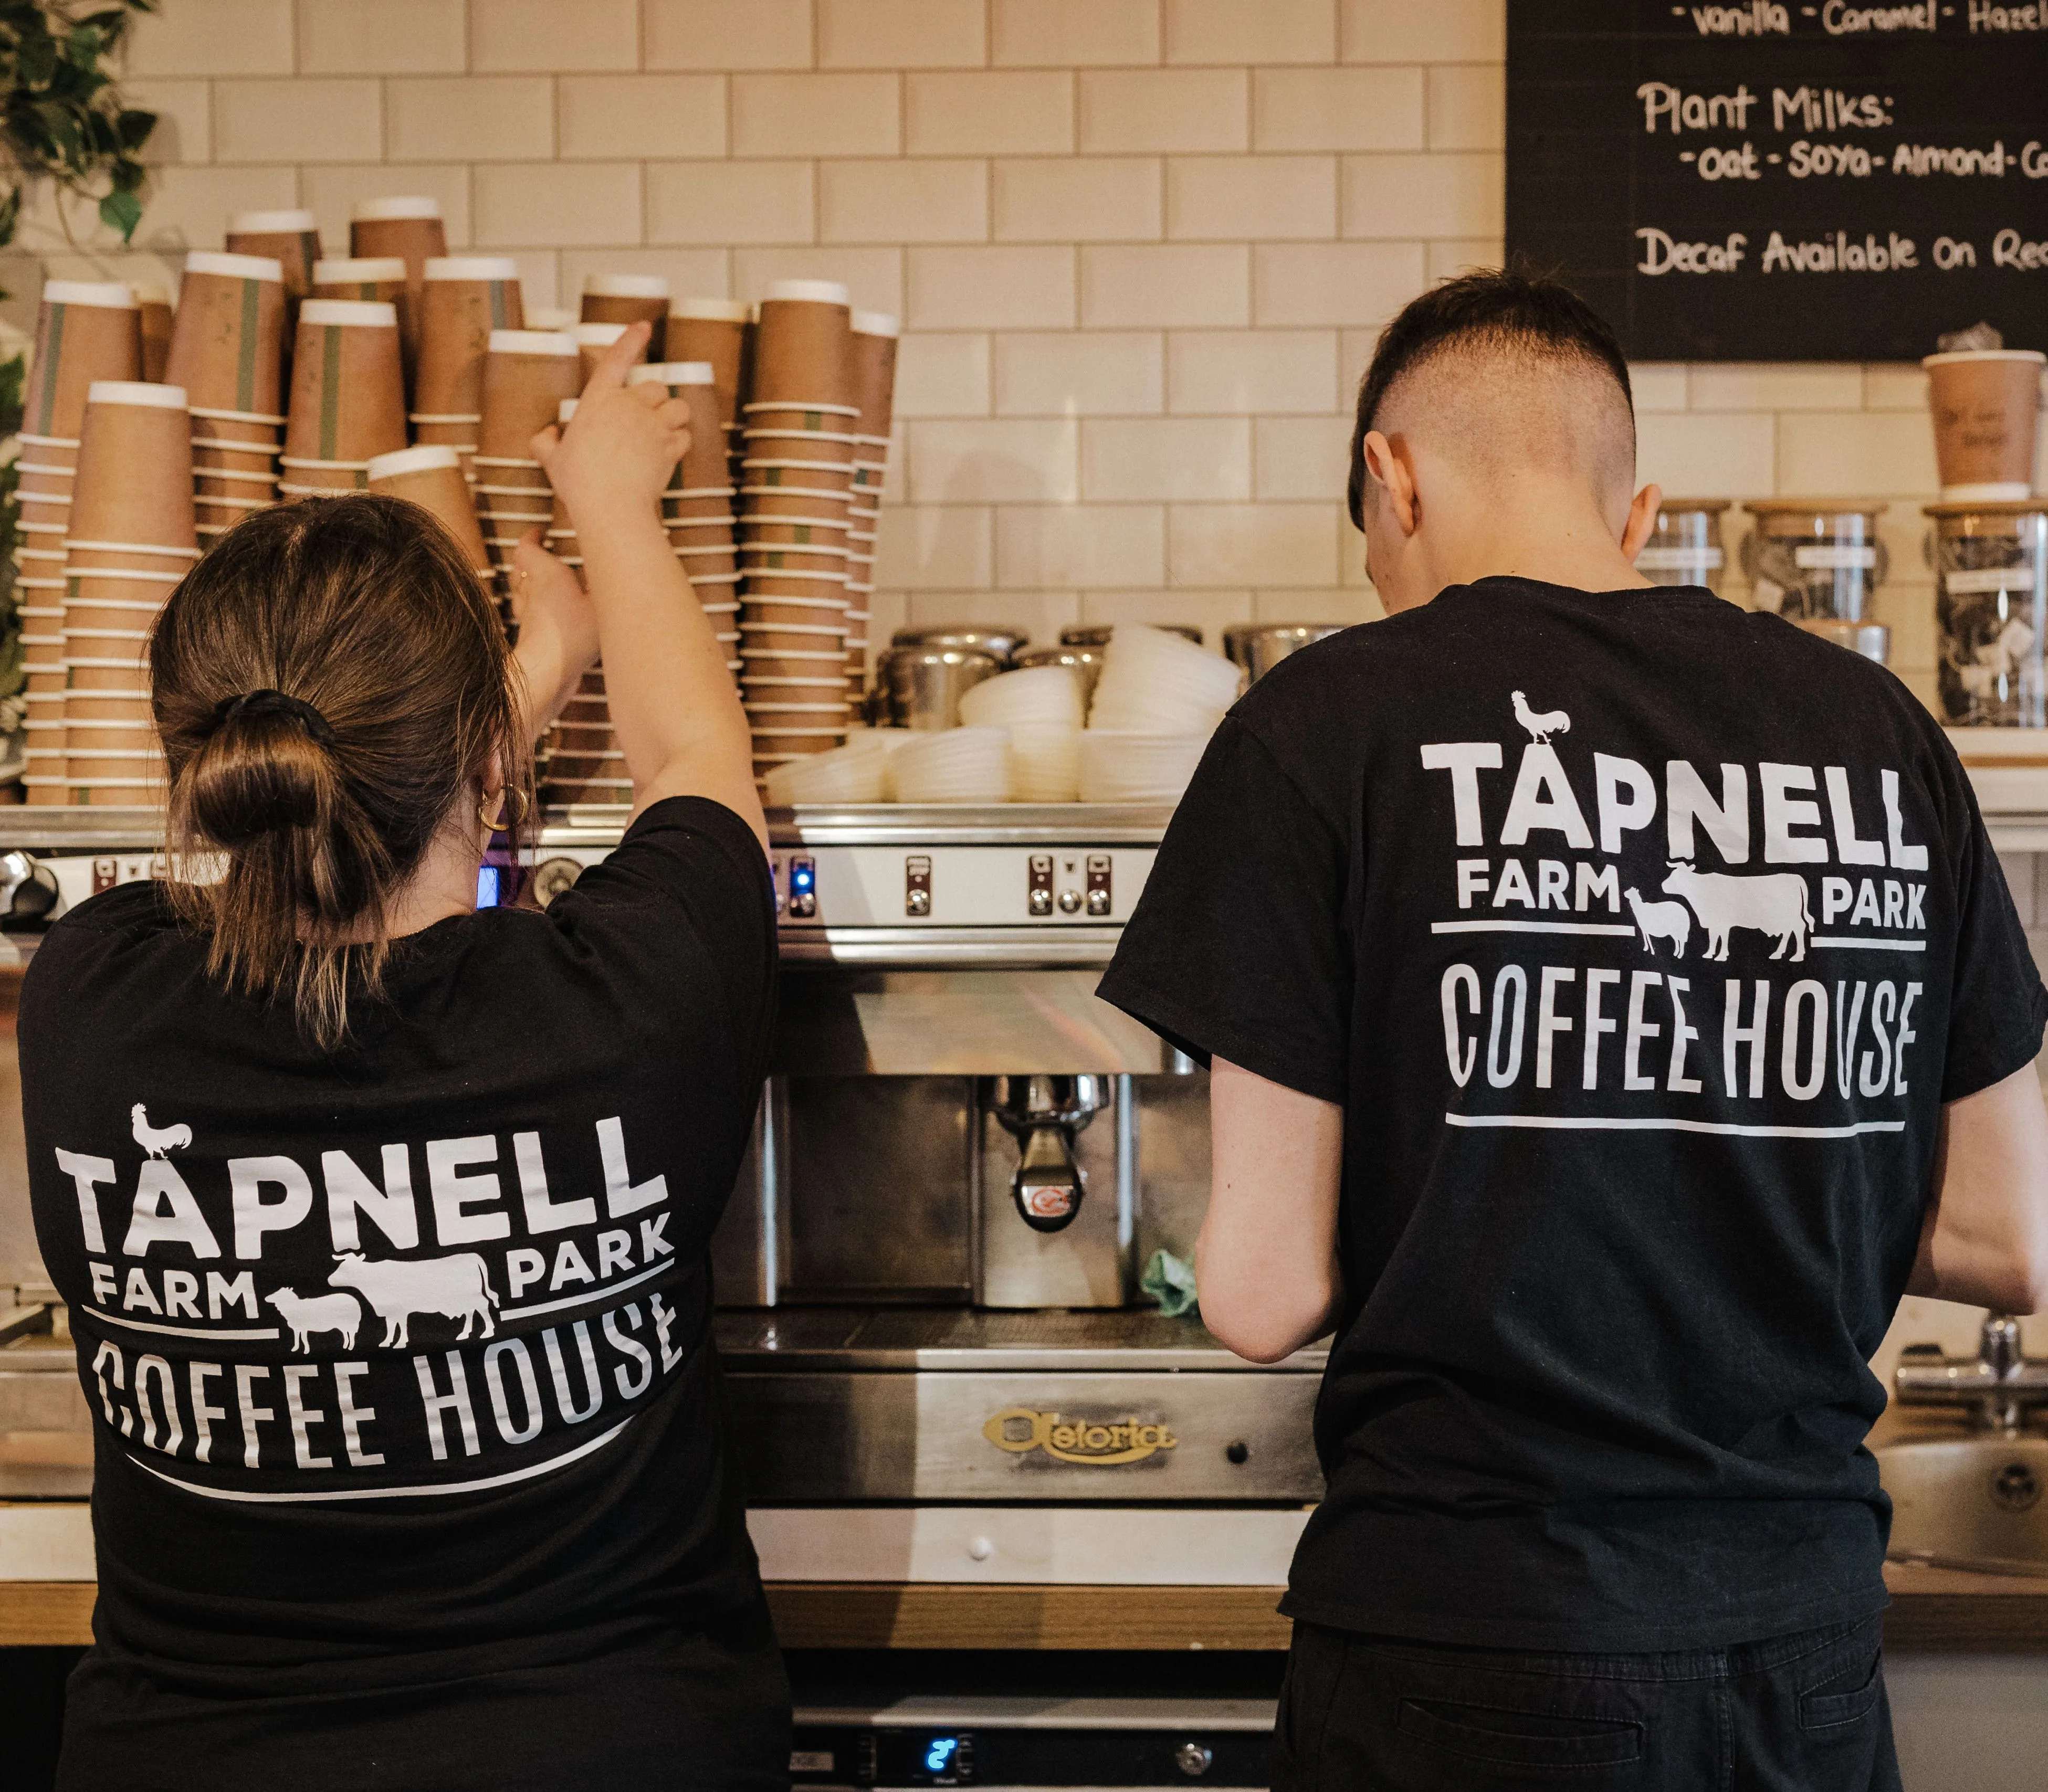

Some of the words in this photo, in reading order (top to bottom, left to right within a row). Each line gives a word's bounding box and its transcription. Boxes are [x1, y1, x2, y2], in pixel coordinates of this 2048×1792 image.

[1636, 82, 1757, 134] Plant
[1772, 86, 1893, 132] Milks:
[1635, 227, 1748, 276] Decaf
[1761, 231, 1919, 273] Available
[1421, 741, 1929, 871] TAPNELL
[1456, 858, 1621, 913] FARM
[1822, 877, 1927, 930] PARK
[1441, 963, 1703, 1093] COFFEE
[1723, 978, 1924, 1101] HOUSE
[55, 1115, 669, 1260] TAPNELL
[89, 1260, 260, 1320] FARM
[506, 1211, 675, 1299] PARK
[91, 1340, 386, 1469] COFFEE
[413, 1292, 683, 1461] HOUSE
